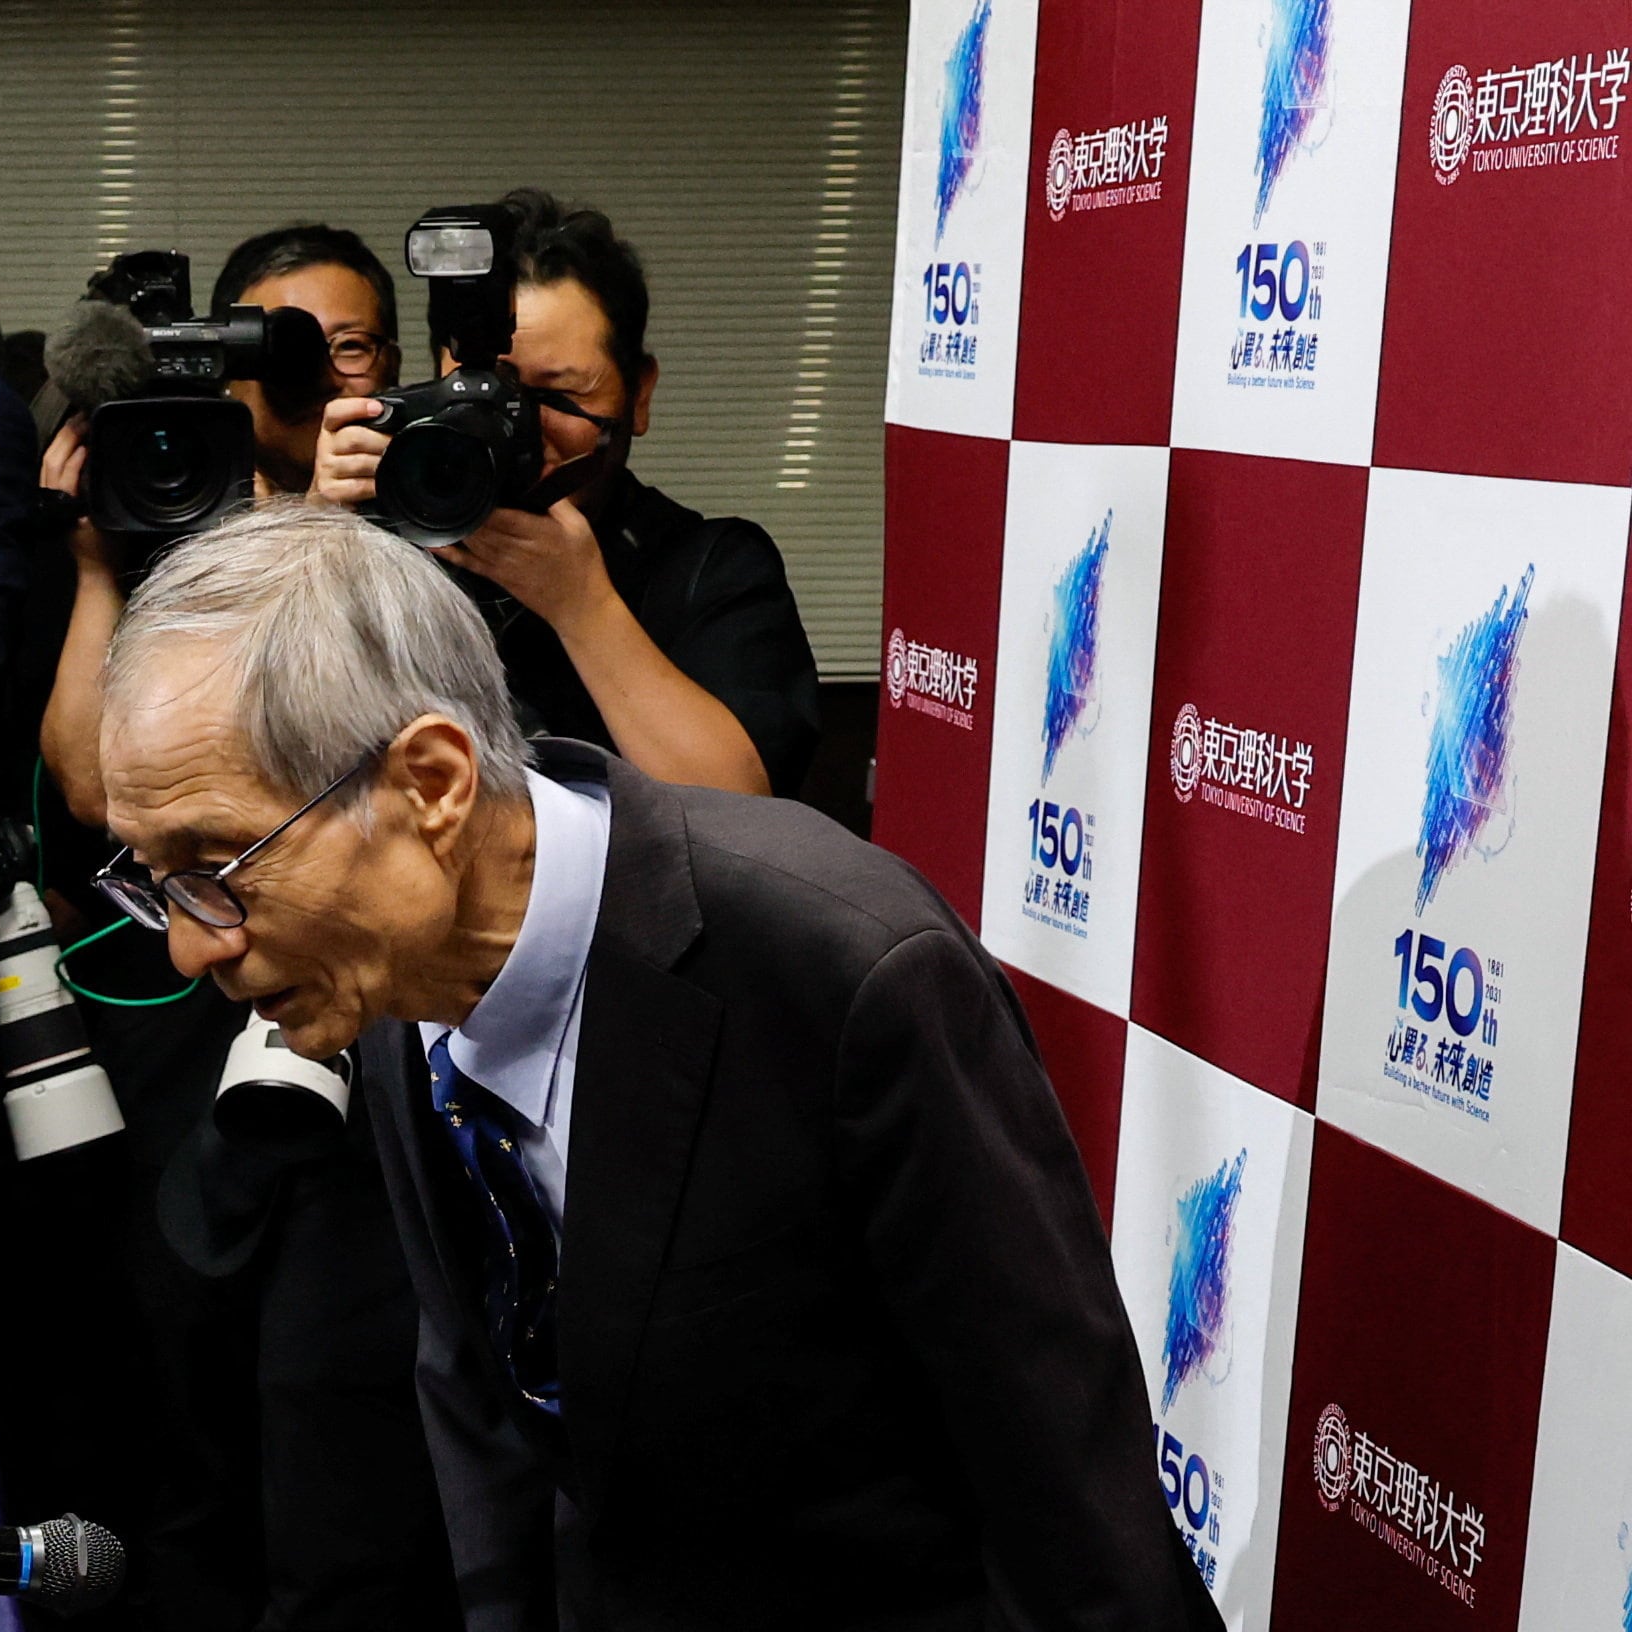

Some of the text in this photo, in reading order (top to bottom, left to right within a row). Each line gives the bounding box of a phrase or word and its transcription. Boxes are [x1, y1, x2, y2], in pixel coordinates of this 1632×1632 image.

[1472, 47, 1631, 145] 東京理科大学
[1072, 115, 1168, 190] 東京理科大学
[1472, 135, 1620, 173] TOKYO UNIVERSITY OF SCIENCE
[1136, 181, 1163, 202] SCIENCE
[923, 261, 971, 326] 150
[1235, 239, 1309, 322] 150
[1309, 286, 1321, 320] th
[152, 329, 181, 337] SONY
[1229, 325, 1319, 373] 心躍る、未来創造
[906, 639, 978, 710] 東京理科大学
[1201, 717, 1314, 809] 東京理科大学
[1028, 798, 1083, 876] 150
[1201, 782, 1307, 835] TOKYO UNIVERSITY OF SCIENCE
[1082, 851, 1093, 881] th
[1394, 928, 1484, 1037] 150
[1485, 983, 1502, 1005] 2031
[1487, 957, 1505, 978] 1881
[1385, 1015, 1494, 1101] 心躍る、未来創造
[1482, 1008, 1498, 1047] th
[1383, 1062, 1407, 1088] Building
[1451, 1093, 1465, 1112] with
[1465, 1098, 1490, 1123] Science
[1209, 1511, 1220, 1546] th
[1350, 1431, 1486, 1578] 東京理科大学
[1350, 1498, 1377, 1534] TOKYO
[1378, 1521, 1426, 1570] UNIVERSITY
[1426, 1555, 1440, 1580] OF
[1439, 1565, 1476, 1610] SCIENCE
